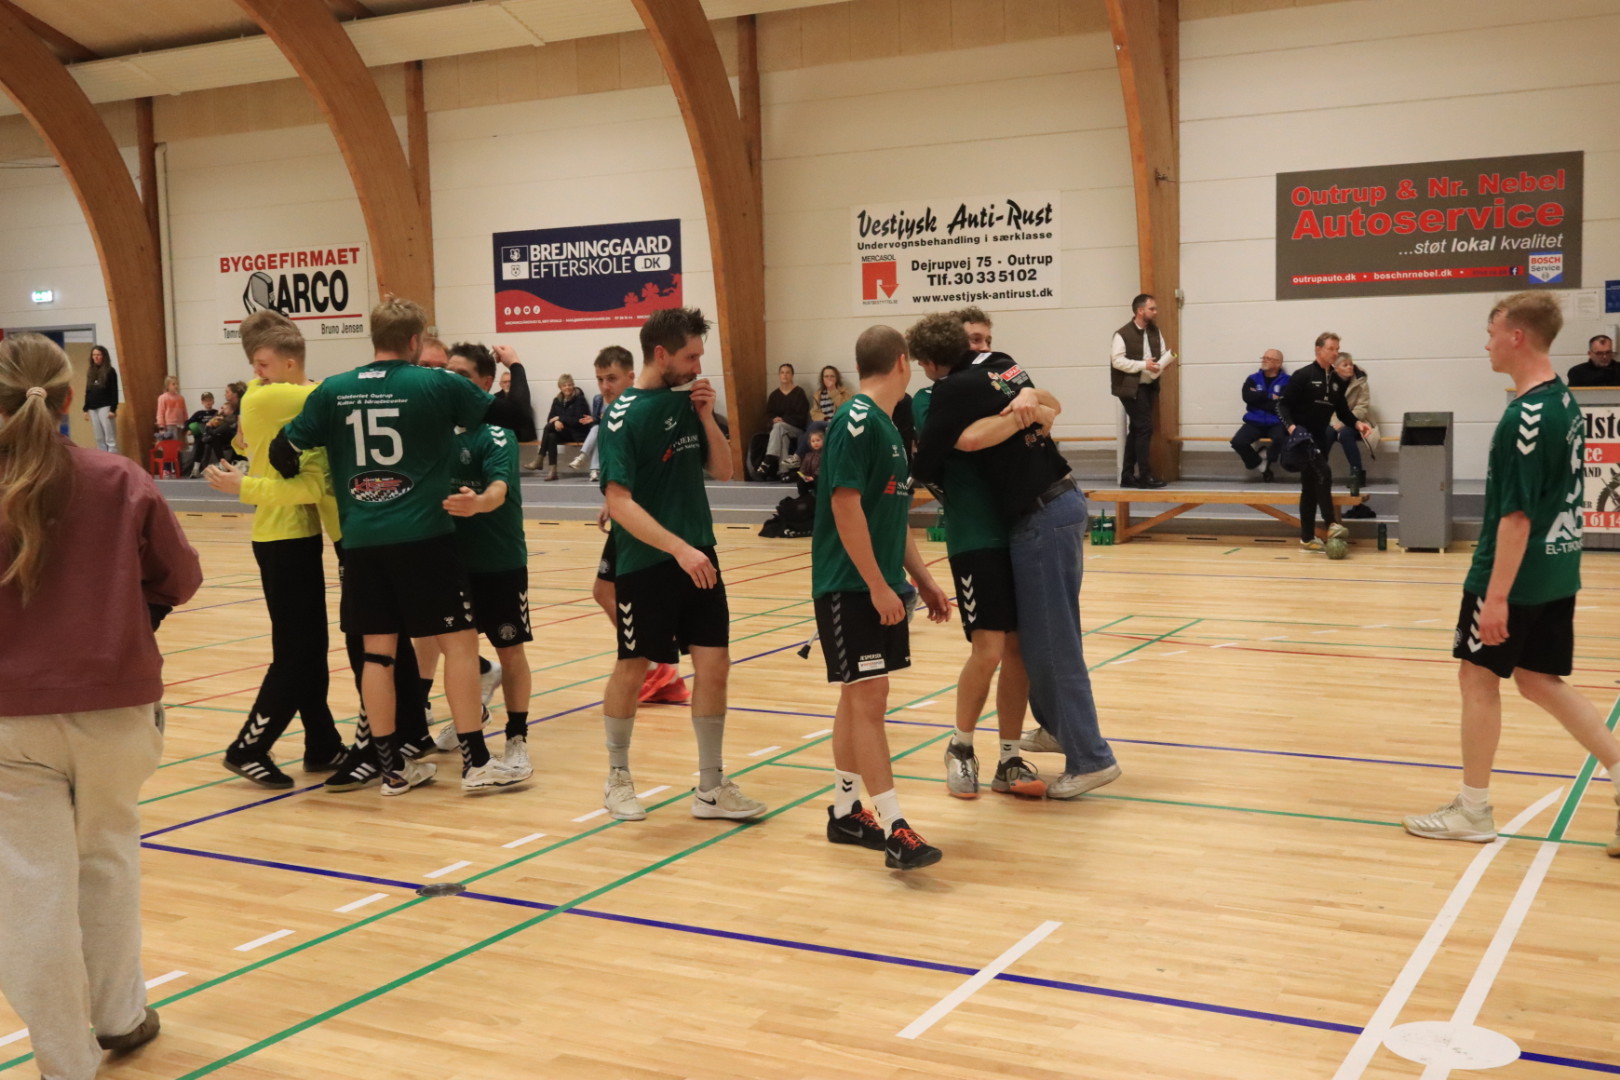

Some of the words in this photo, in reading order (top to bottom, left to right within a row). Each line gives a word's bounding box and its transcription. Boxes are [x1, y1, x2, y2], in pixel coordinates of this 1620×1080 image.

[1291, 186, 1387, 207] Outrup
[1396, 179, 1418, 200] &
[1428, 177, 1468, 198] Nr.
[1478, 169, 1565, 195] Nebel
[857, 207, 937, 240] Vestjysk
[947, 199, 1053, 234] Anti-Rust
[1291, 198, 1564, 240] Autoservice
[530, 235, 671, 262] BREJNINGGAARD
[857, 236, 980, 250] Undervognsbehandling
[984, 234, 988, 243] i
[992, 231, 1053, 242] særklasse
[1451, 236, 1496, 252] lokal
[1500, 233, 1563, 250] kvalitet
[220, 247, 360, 273] BYGGEFIRMAET
[531, 256, 631, 279] EFTERSKOLE
[861, 254, 896, 262] MERCASOL
[911, 257, 971, 273] Dejrupvej
[976, 256, 992, 268] 75
[1007, 254, 1053, 266] Outrup
[1530, 256, 1561, 264] BOSCH
[1292, 273, 1356, 283] outrupauto.dk
[1373, 269, 1452, 280] boschnrnebel.dk
[277, 269, 349, 314] ARCO
[912, 288, 1053, 303] www.vestjysk-antirust.dk
[321, 323, 340, 335] Bruno
[341, 322, 364, 334] Jensen
[345, 407, 404, 467] 15
